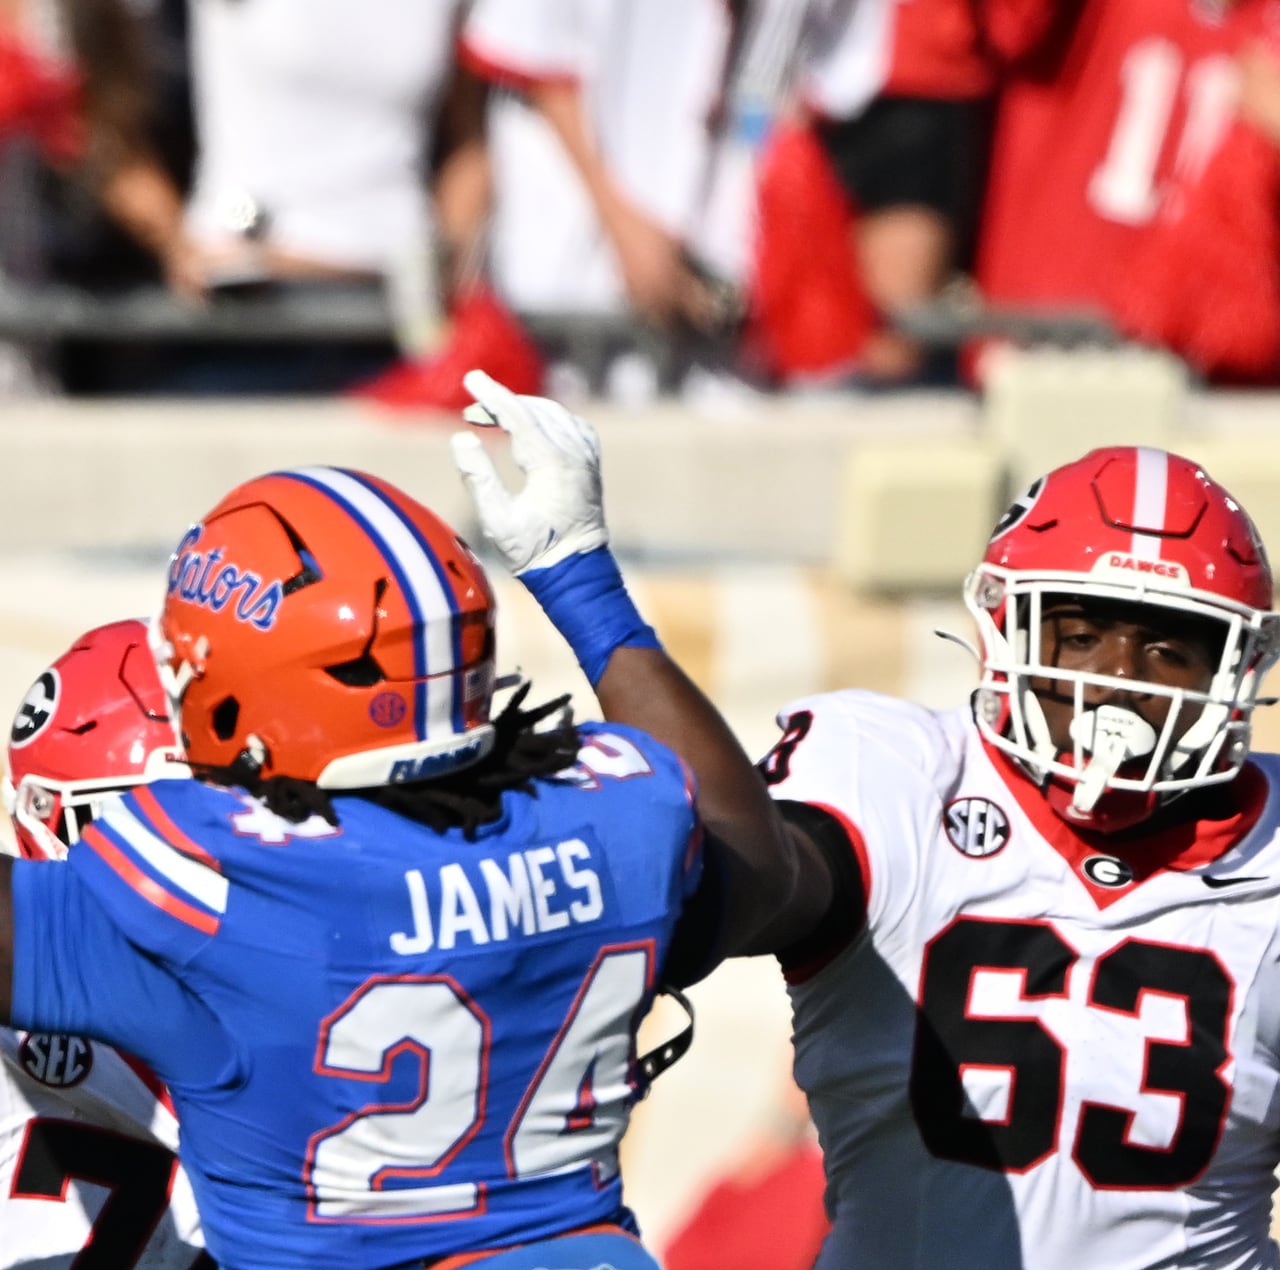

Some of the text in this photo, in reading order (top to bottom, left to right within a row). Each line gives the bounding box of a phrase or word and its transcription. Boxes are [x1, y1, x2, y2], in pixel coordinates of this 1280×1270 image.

[167, 524, 282, 632] Gators
[1109, 555, 1180, 579] DAWGS
[946, 799, 1010, 855] SEC
[389, 837, 604, 956] JAMES
[1083, 856, 1133, 887] G
[23, 1034, 91, 1087] SEC
[302, 936, 658, 1226] 24
[909, 912, 1237, 1192] 63
